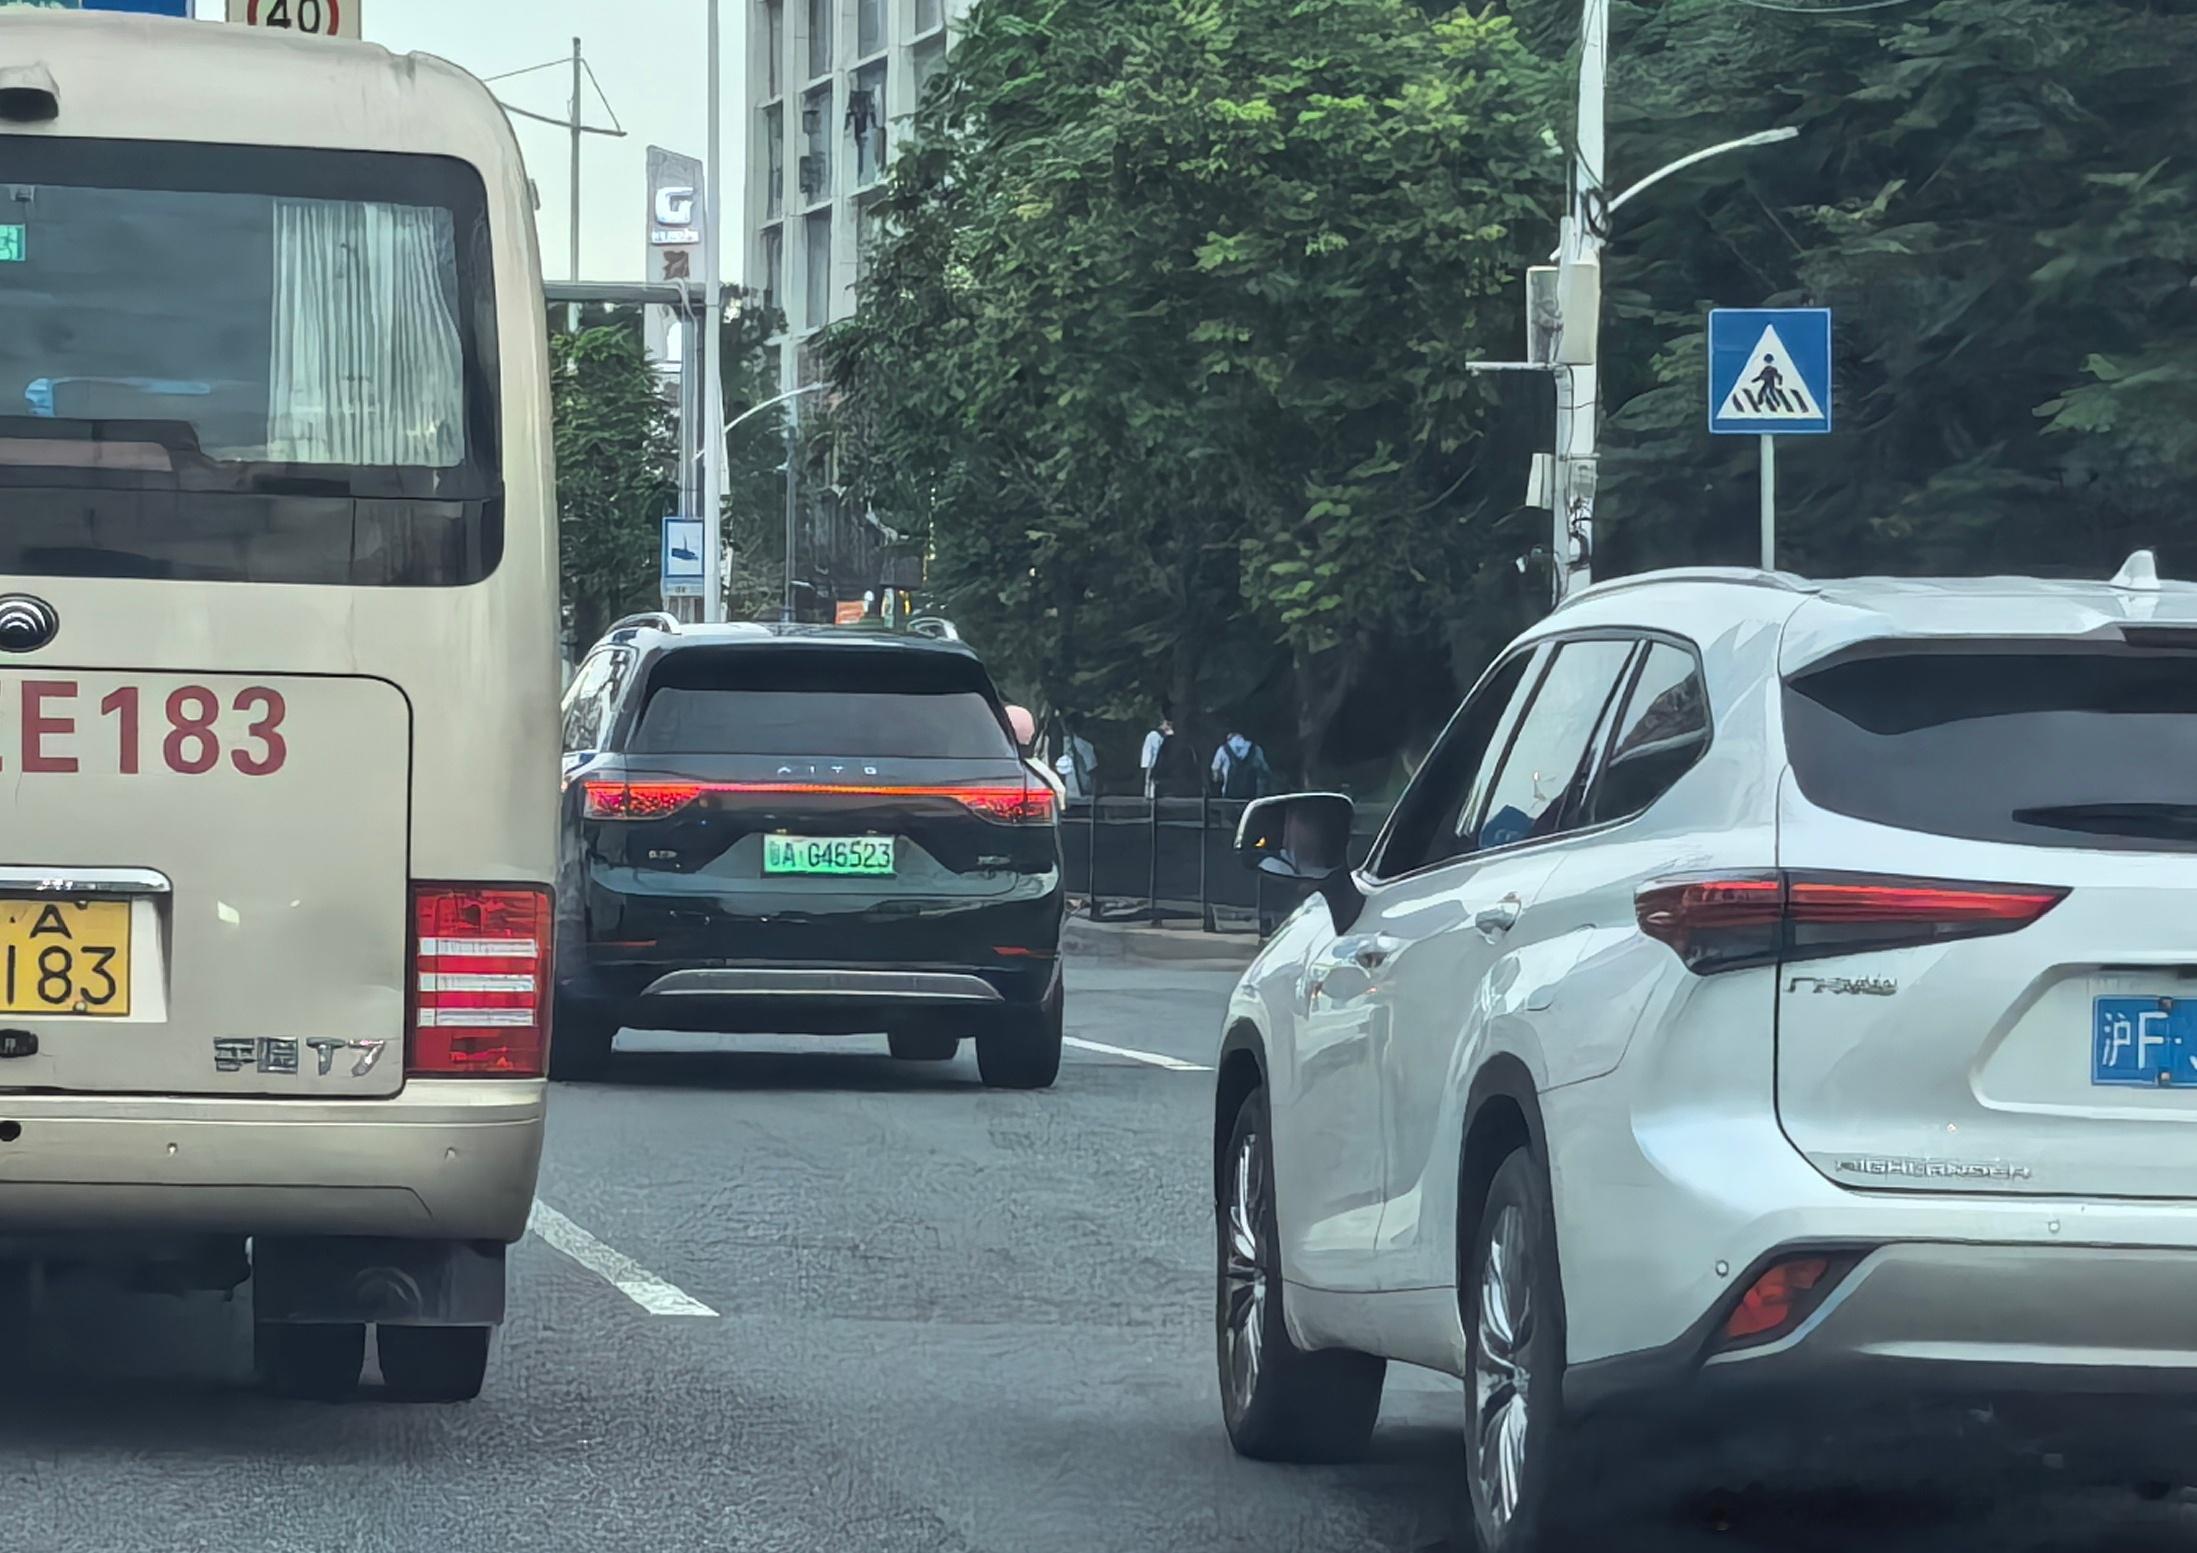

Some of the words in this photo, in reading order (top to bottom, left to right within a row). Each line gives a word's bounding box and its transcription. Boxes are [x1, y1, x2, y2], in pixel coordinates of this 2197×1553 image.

[266, 0, 321, 34] 40
[0, 680, 287, 776] E183
[7, 944, 117, 1006] 183
[2102, 1010, 2197, 1071] 沪F·
